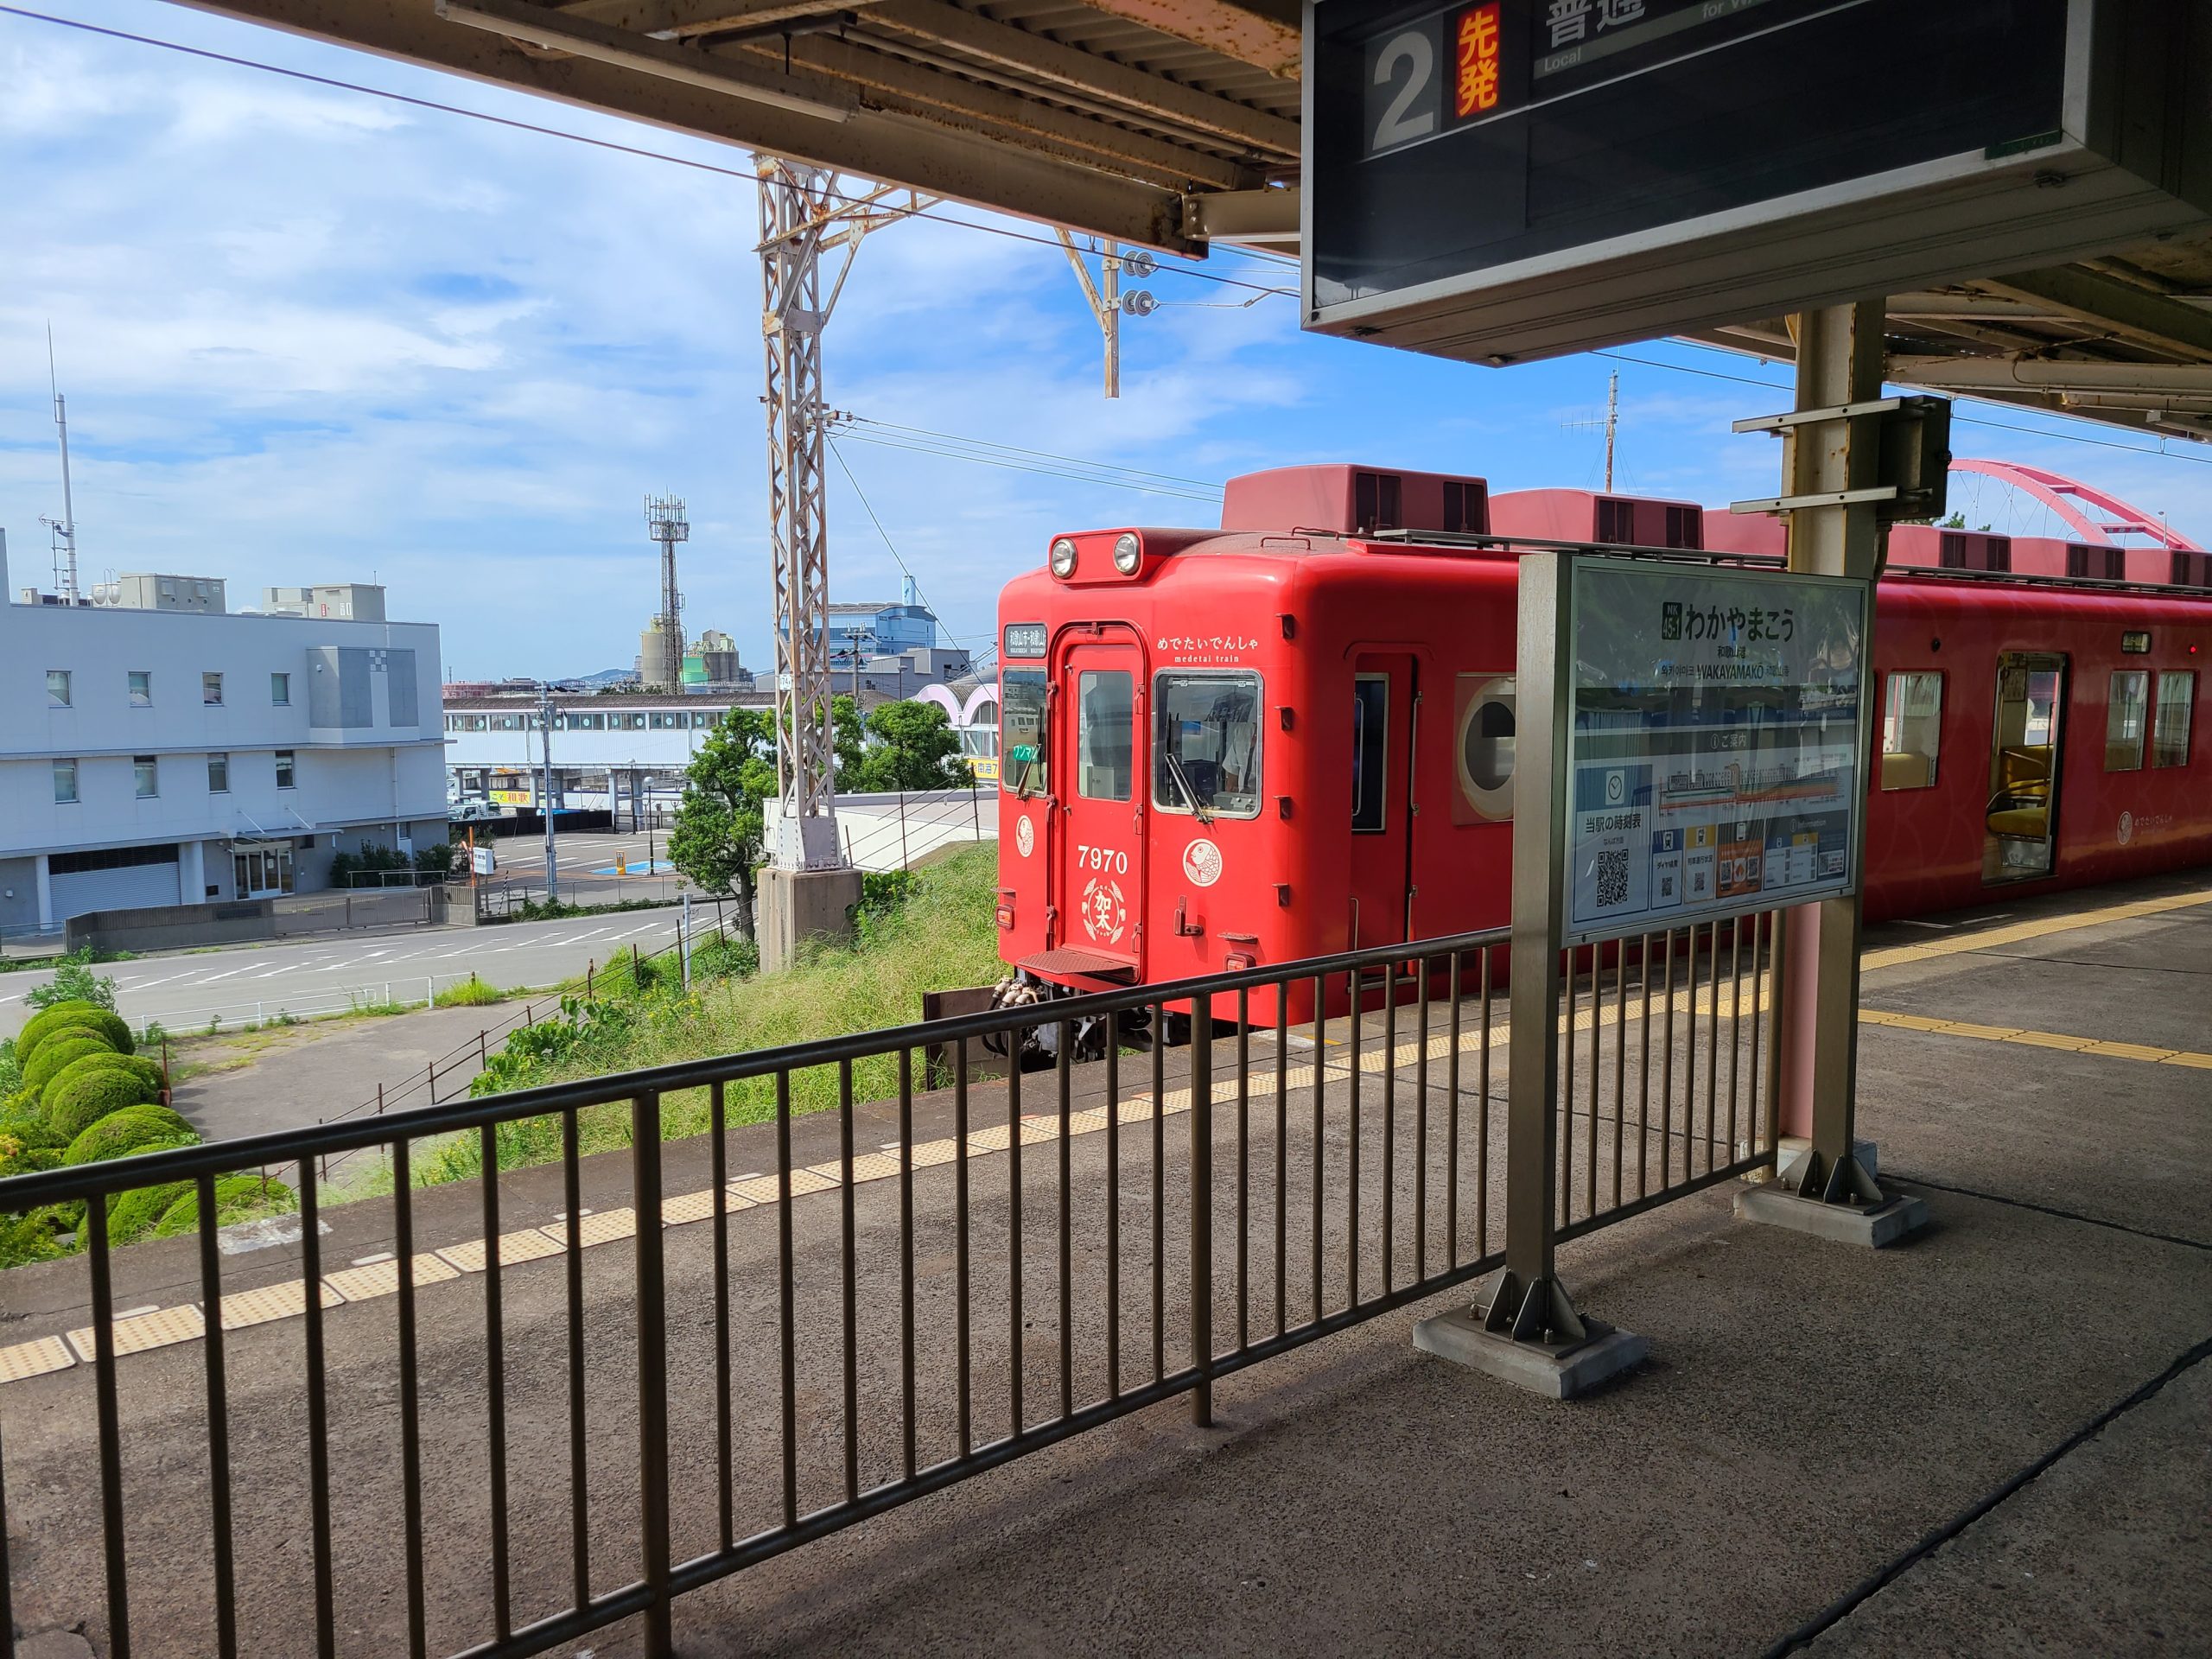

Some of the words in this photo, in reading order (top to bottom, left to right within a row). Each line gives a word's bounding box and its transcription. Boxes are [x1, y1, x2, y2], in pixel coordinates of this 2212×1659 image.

[1702, 2, 1725, 20] for
[1458, 11, 1498, 118] 先発
[1544, 47, 1582, 73] Local
[1372, 31, 1434, 151] 2
[1667, 605, 1678, 615] NK
[1662, 617, 1680, 639] 45-1
[1685, 604, 1794, 643] わかやまこう
[1157, 636, 1258, 650] めでたいでんしゃ
[1175, 654, 1211, 663] medetai
[1216, 654, 1239, 663] train
[1721, 733, 1746, 748] ご案内
[1586, 813, 1642, 834] 当駅の時刻表
[1077, 844, 1128, 874] 7970
[1094, 890, 1113, 931] 加太
